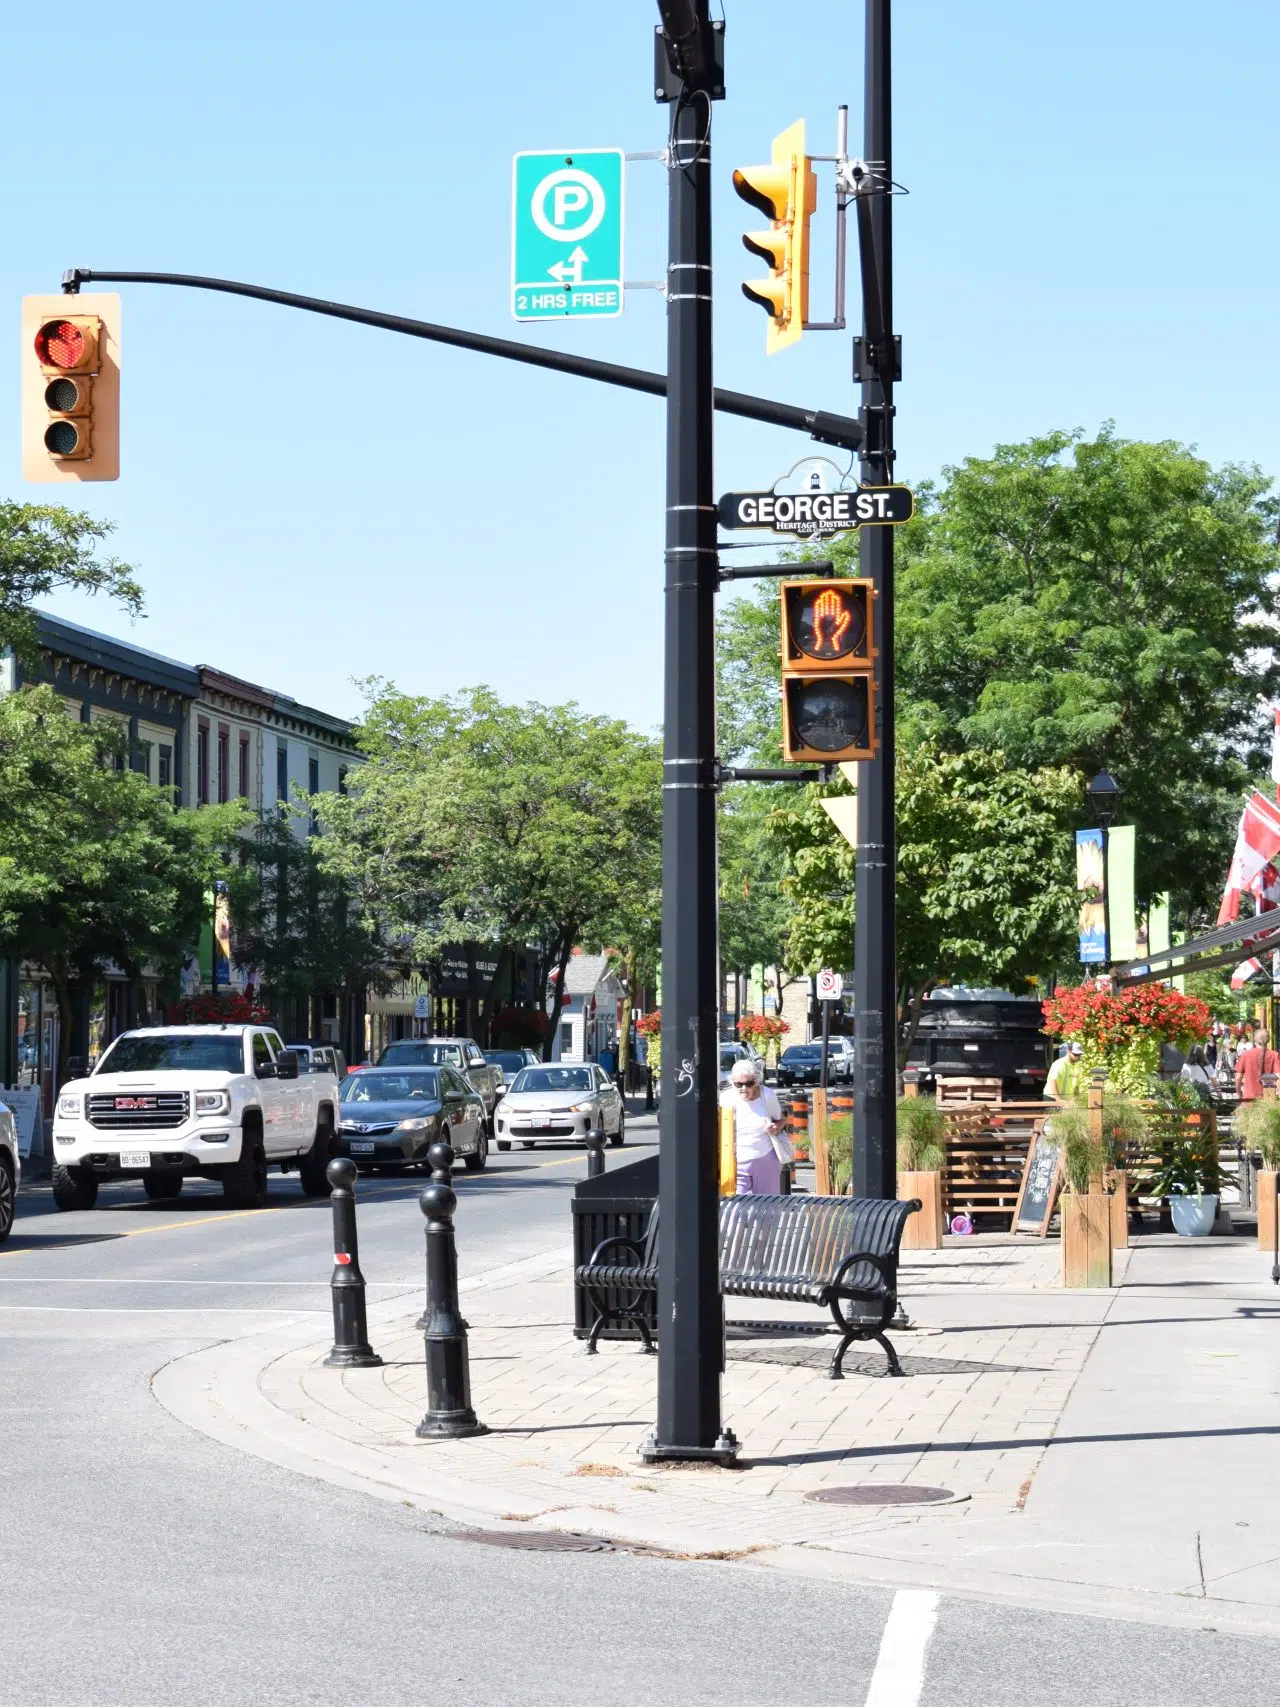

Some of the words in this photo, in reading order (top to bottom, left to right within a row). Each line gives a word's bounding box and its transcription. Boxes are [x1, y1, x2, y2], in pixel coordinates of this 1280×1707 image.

[554, 186, 589, 225] P
[517, 295, 528, 310] 2
[531, 293, 567, 309] HRS
[571, 291, 617, 308] FREE
[737, 495, 850, 523] GEORGE
[856, 493, 893, 519] ST.
[115, 1097, 157, 1109] GMC
